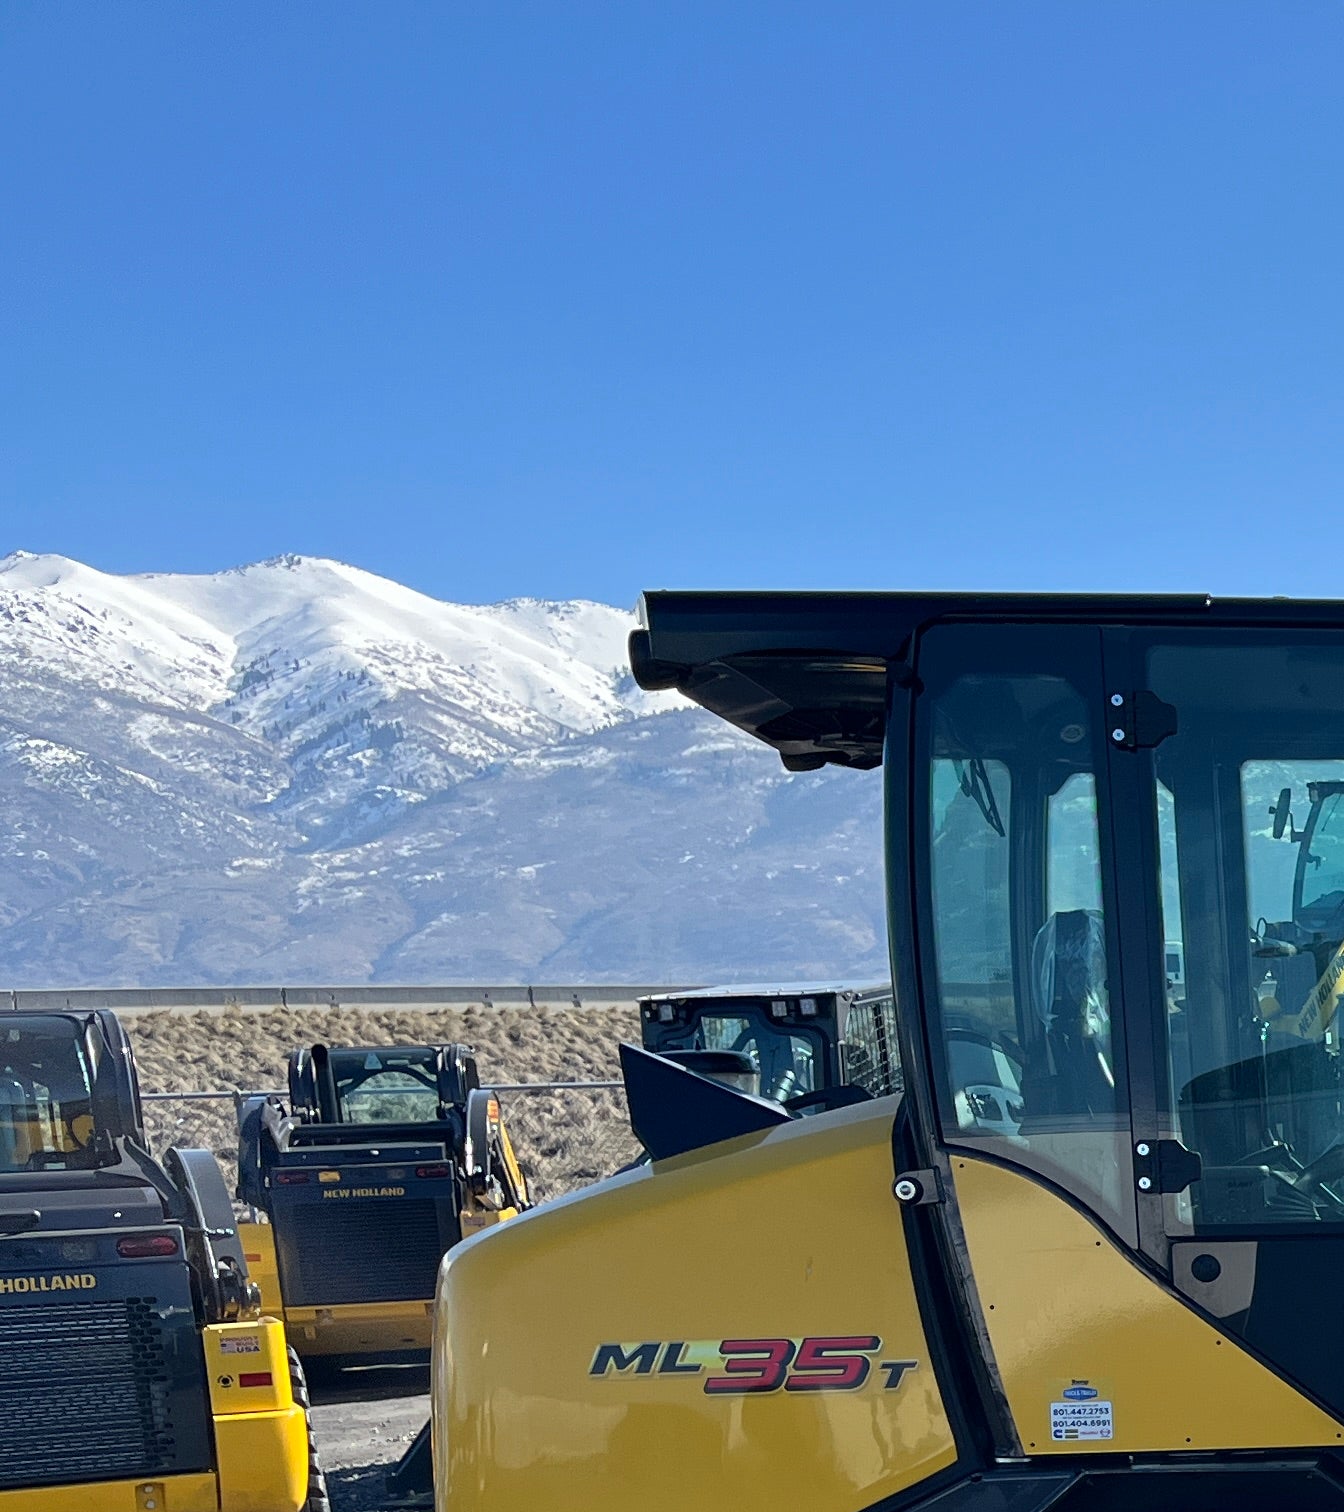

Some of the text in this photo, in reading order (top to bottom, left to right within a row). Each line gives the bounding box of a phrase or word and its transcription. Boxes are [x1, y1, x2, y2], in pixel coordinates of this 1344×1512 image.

[323, 1187, 405, 1198] NEW HOLLAND
[0, 1273, 97, 1294] HOLLAND
[1053, 1407, 1110, 1416] 801.447.2753
[1053, 1420, 1111, 1428] 801.404.6991
